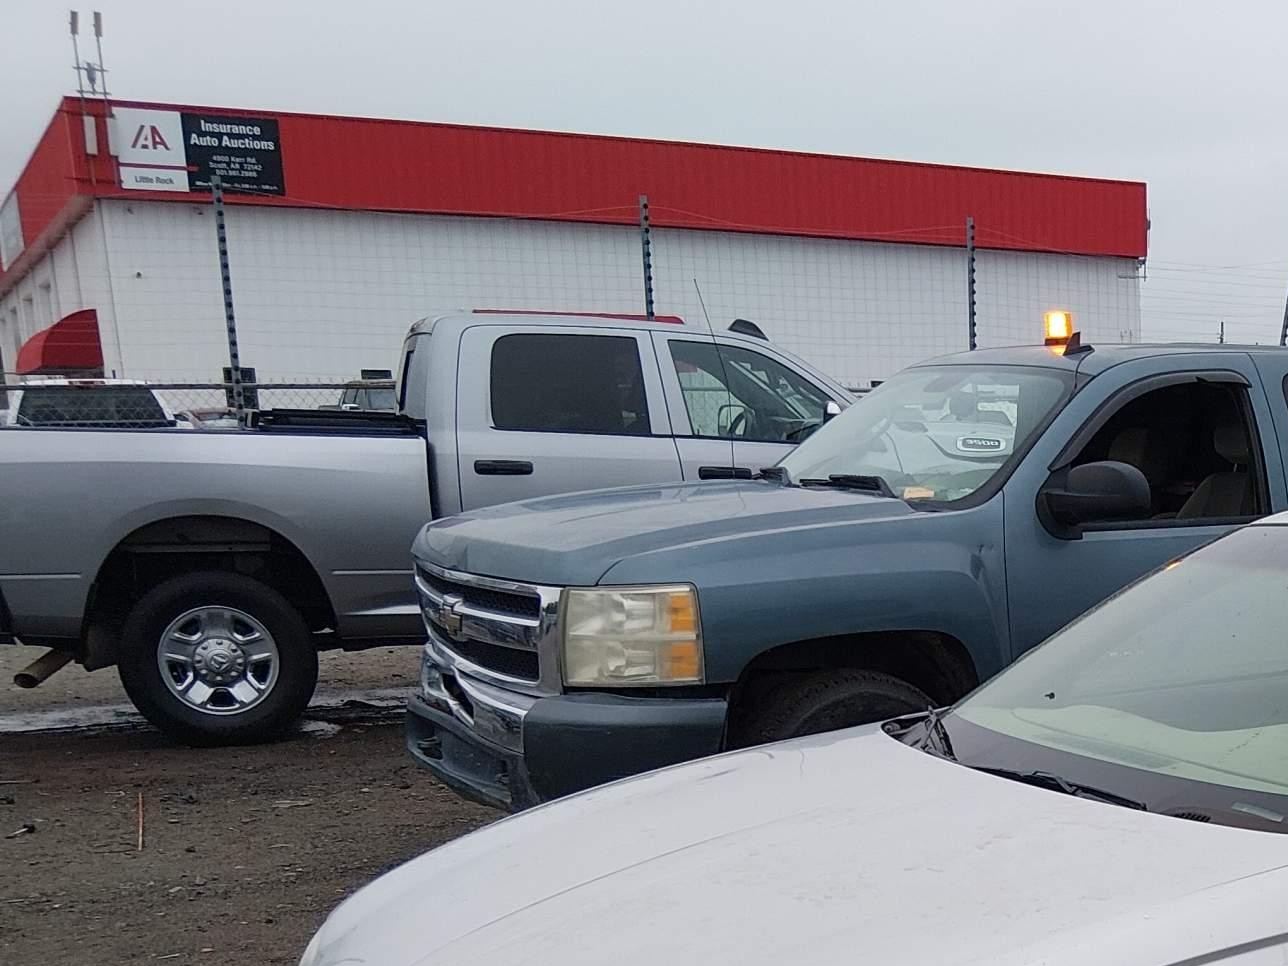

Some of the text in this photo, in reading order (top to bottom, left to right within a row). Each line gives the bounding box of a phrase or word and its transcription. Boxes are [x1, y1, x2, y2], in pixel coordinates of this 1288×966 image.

[200, 119, 261, 135] Insurance
[190, 133, 275, 150] Auto Auctions
[135, 175, 175, 185] Little Rock
